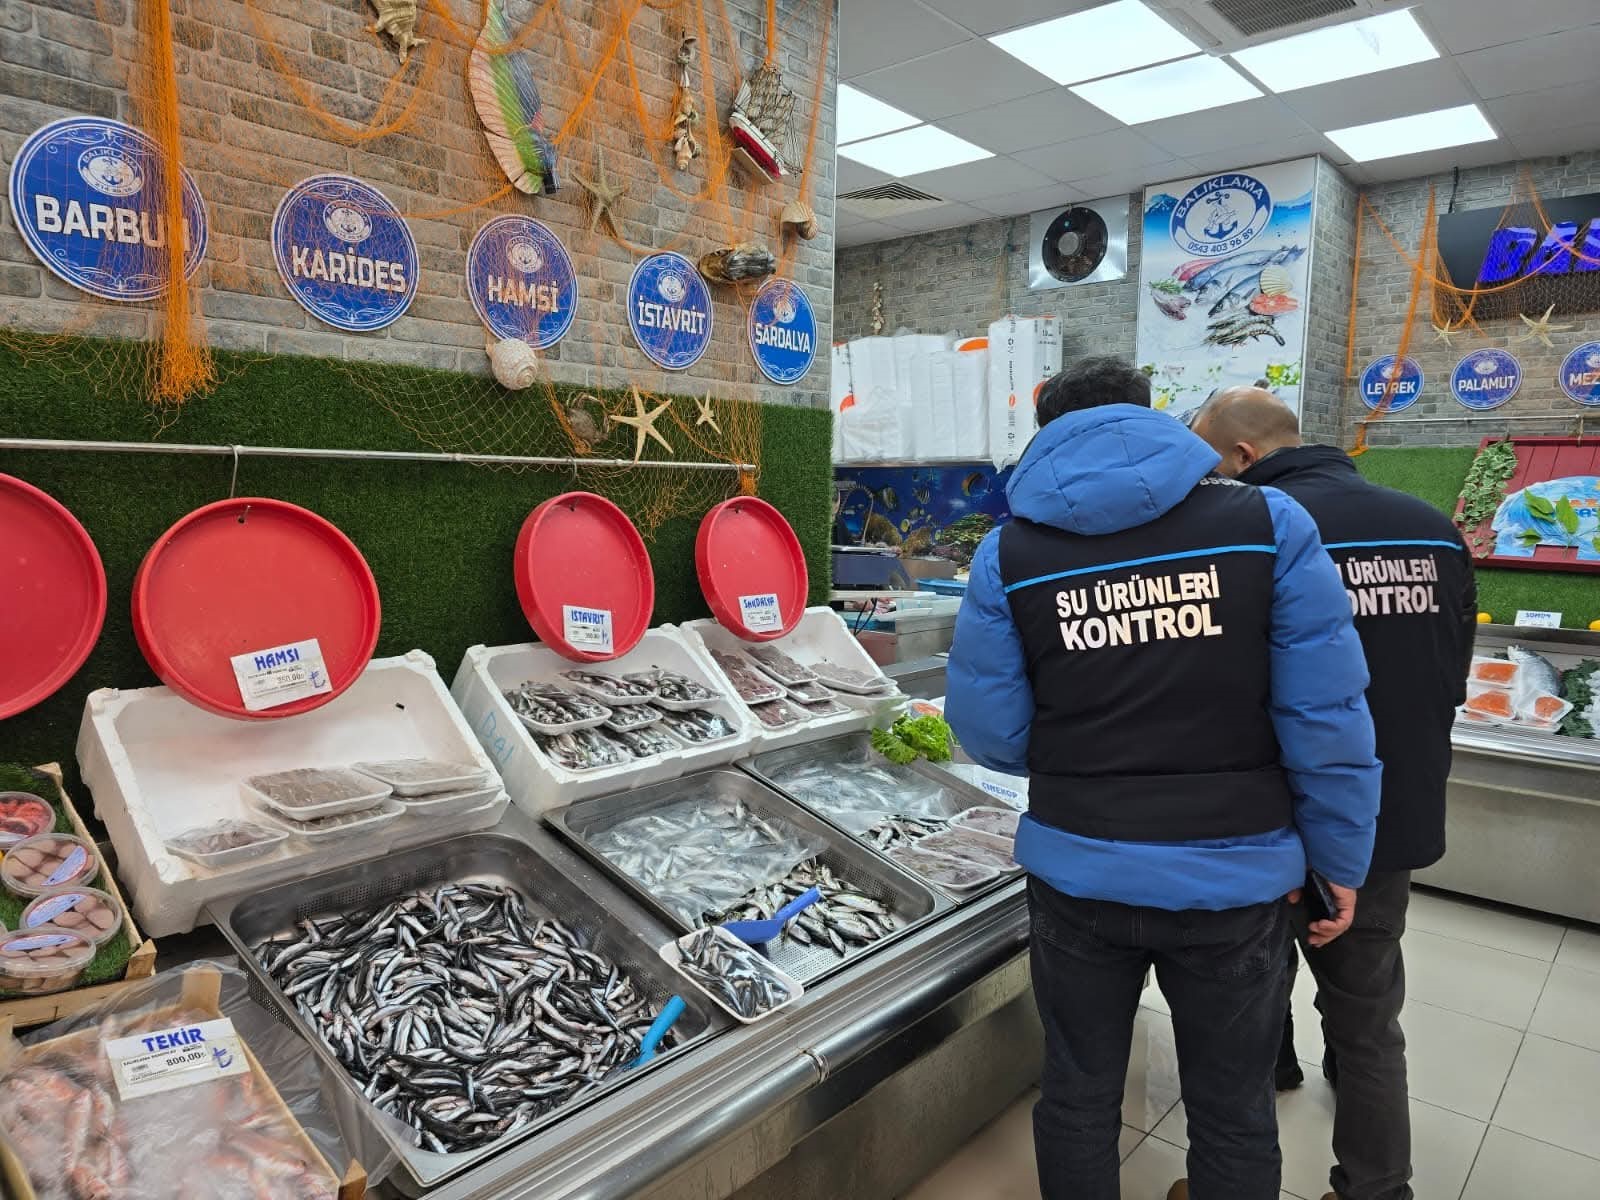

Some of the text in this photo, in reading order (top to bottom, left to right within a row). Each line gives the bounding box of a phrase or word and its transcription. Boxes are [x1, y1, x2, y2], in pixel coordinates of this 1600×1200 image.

[1176, 176, 1263, 218] BALIKLAMA
[1188, 242, 1208, 253] 0543
[1211, 244, 1228, 253] 403
[292, 245, 406, 293] KARİDES
[487, 274, 559, 313] HAMSİ
[638, 295, 705, 335] İSTAVRİT
[755, 323, 811, 354] SARDALYA
[1367, 382, 1415, 395] LEVREK
[1458, 376, 1515, 391] PALAMUT
[1346, 554, 1438, 585] ÜRÜNLERİ
[1056, 564, 1220, 618] SU ÜRÜNLERİ
[1345, 585, 1440, 616] ONTROL
[1060, 603, 1223, 650] KONTROL
[142, 1028, 205, 1052] TEKİR
